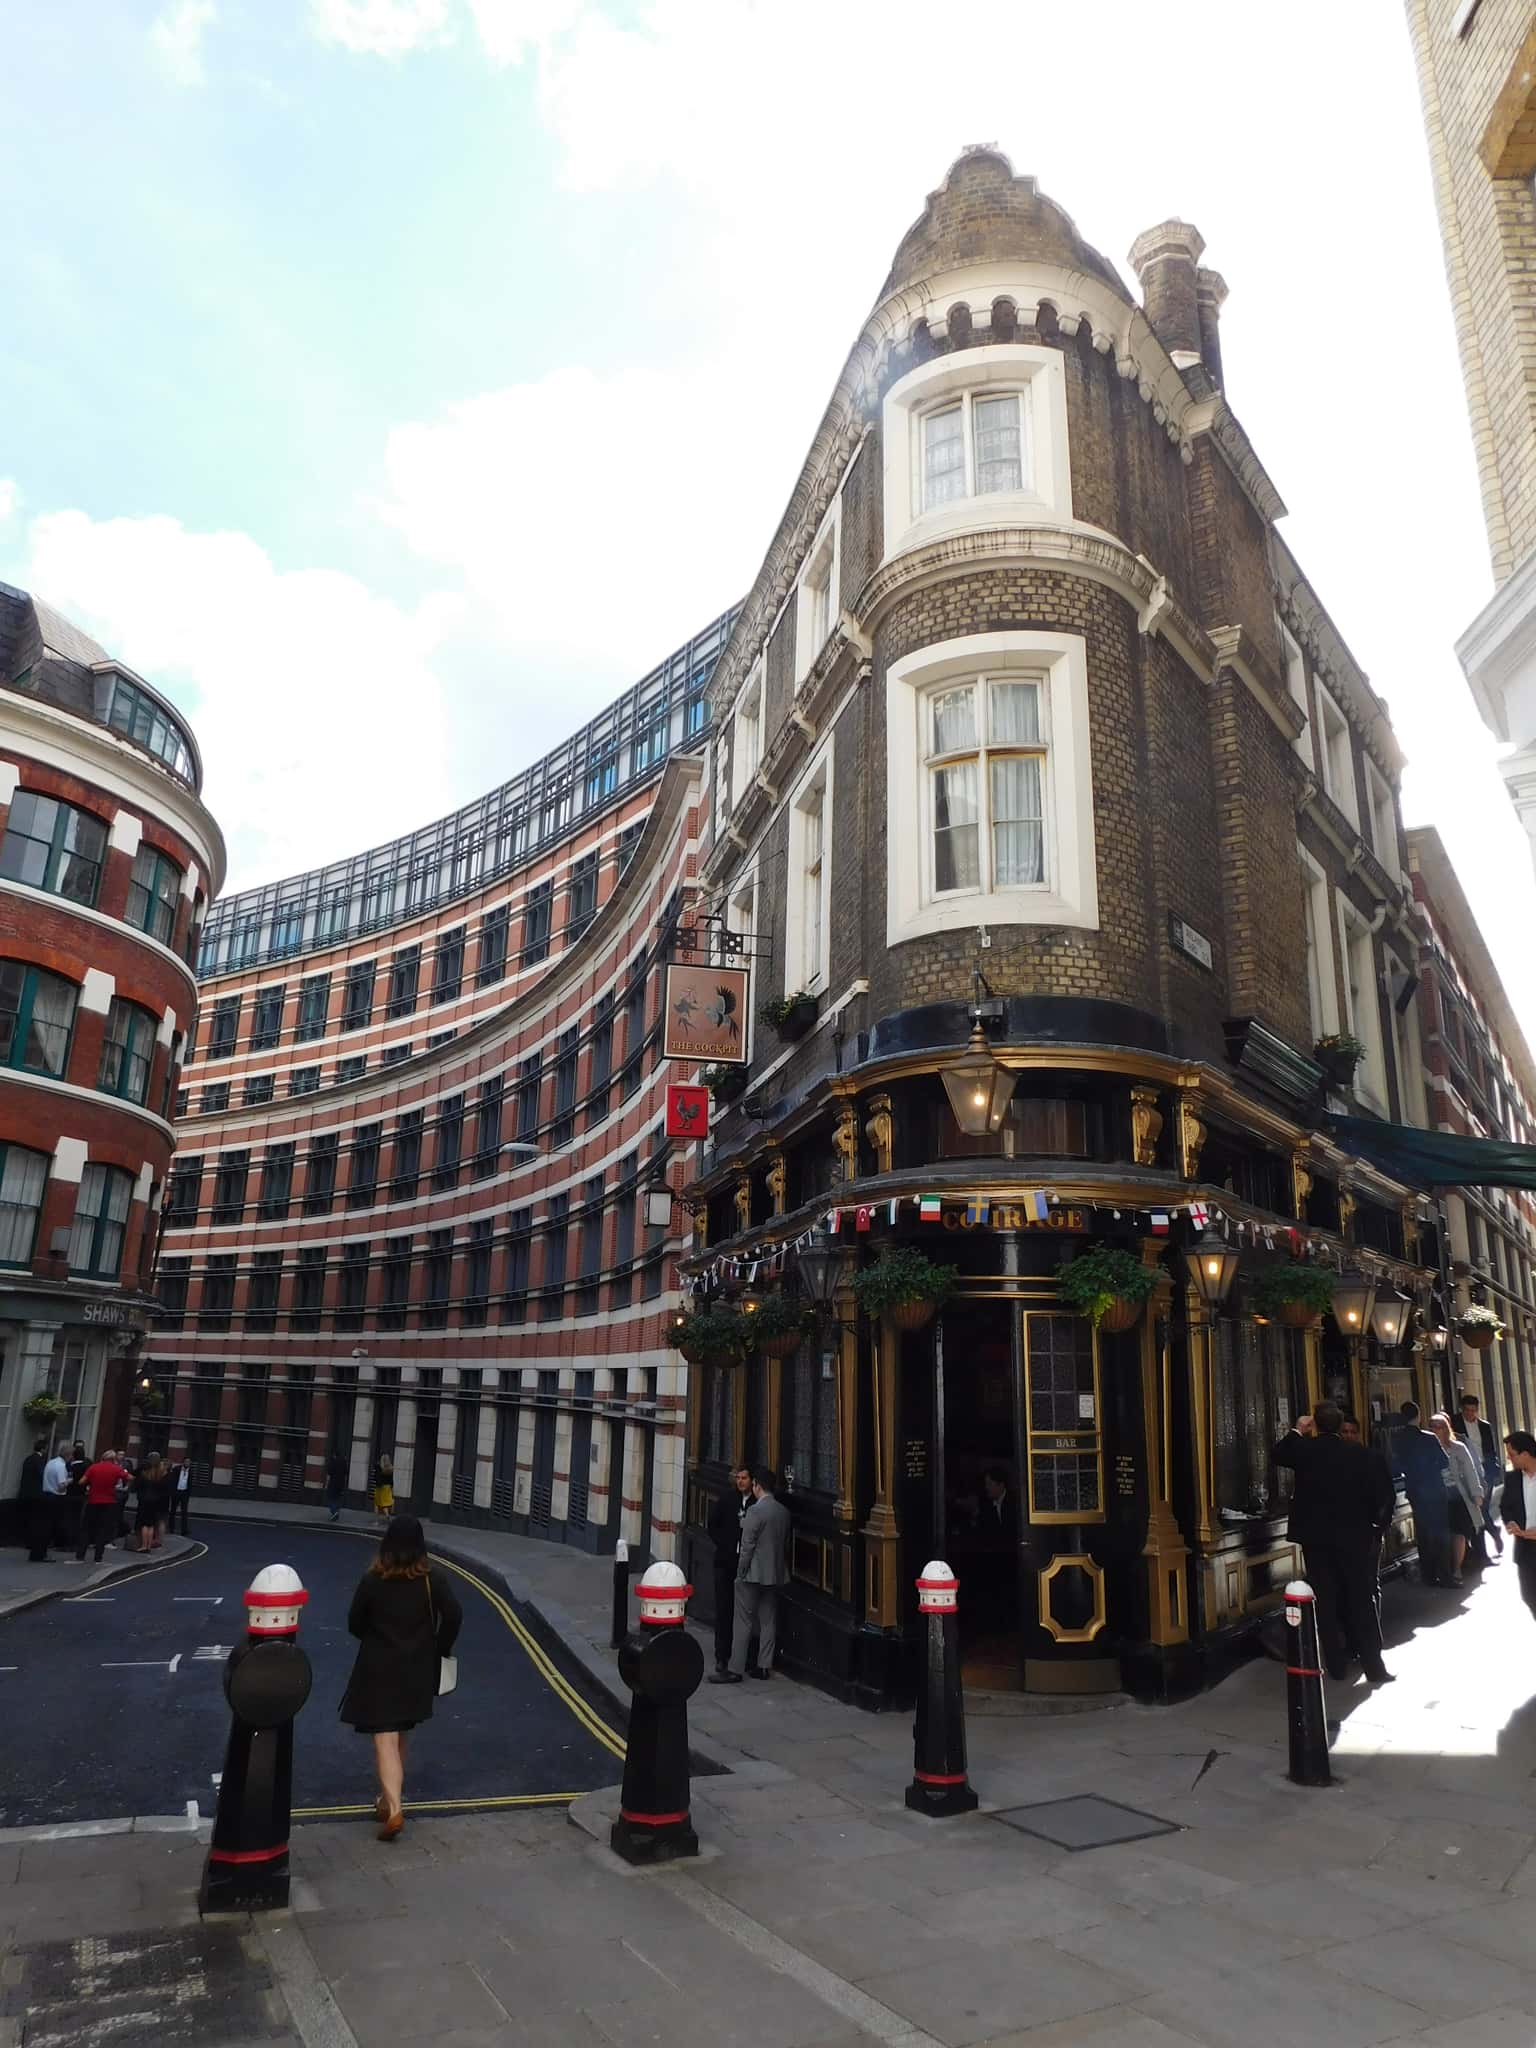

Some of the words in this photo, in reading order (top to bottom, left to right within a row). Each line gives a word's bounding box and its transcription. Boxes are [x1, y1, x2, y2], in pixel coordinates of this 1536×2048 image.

[672, 1040, 692, 1050] THE
[694, 1042, 738, 1055] COCKPIT
[1055, 1438, 1077, 1448] BAR
